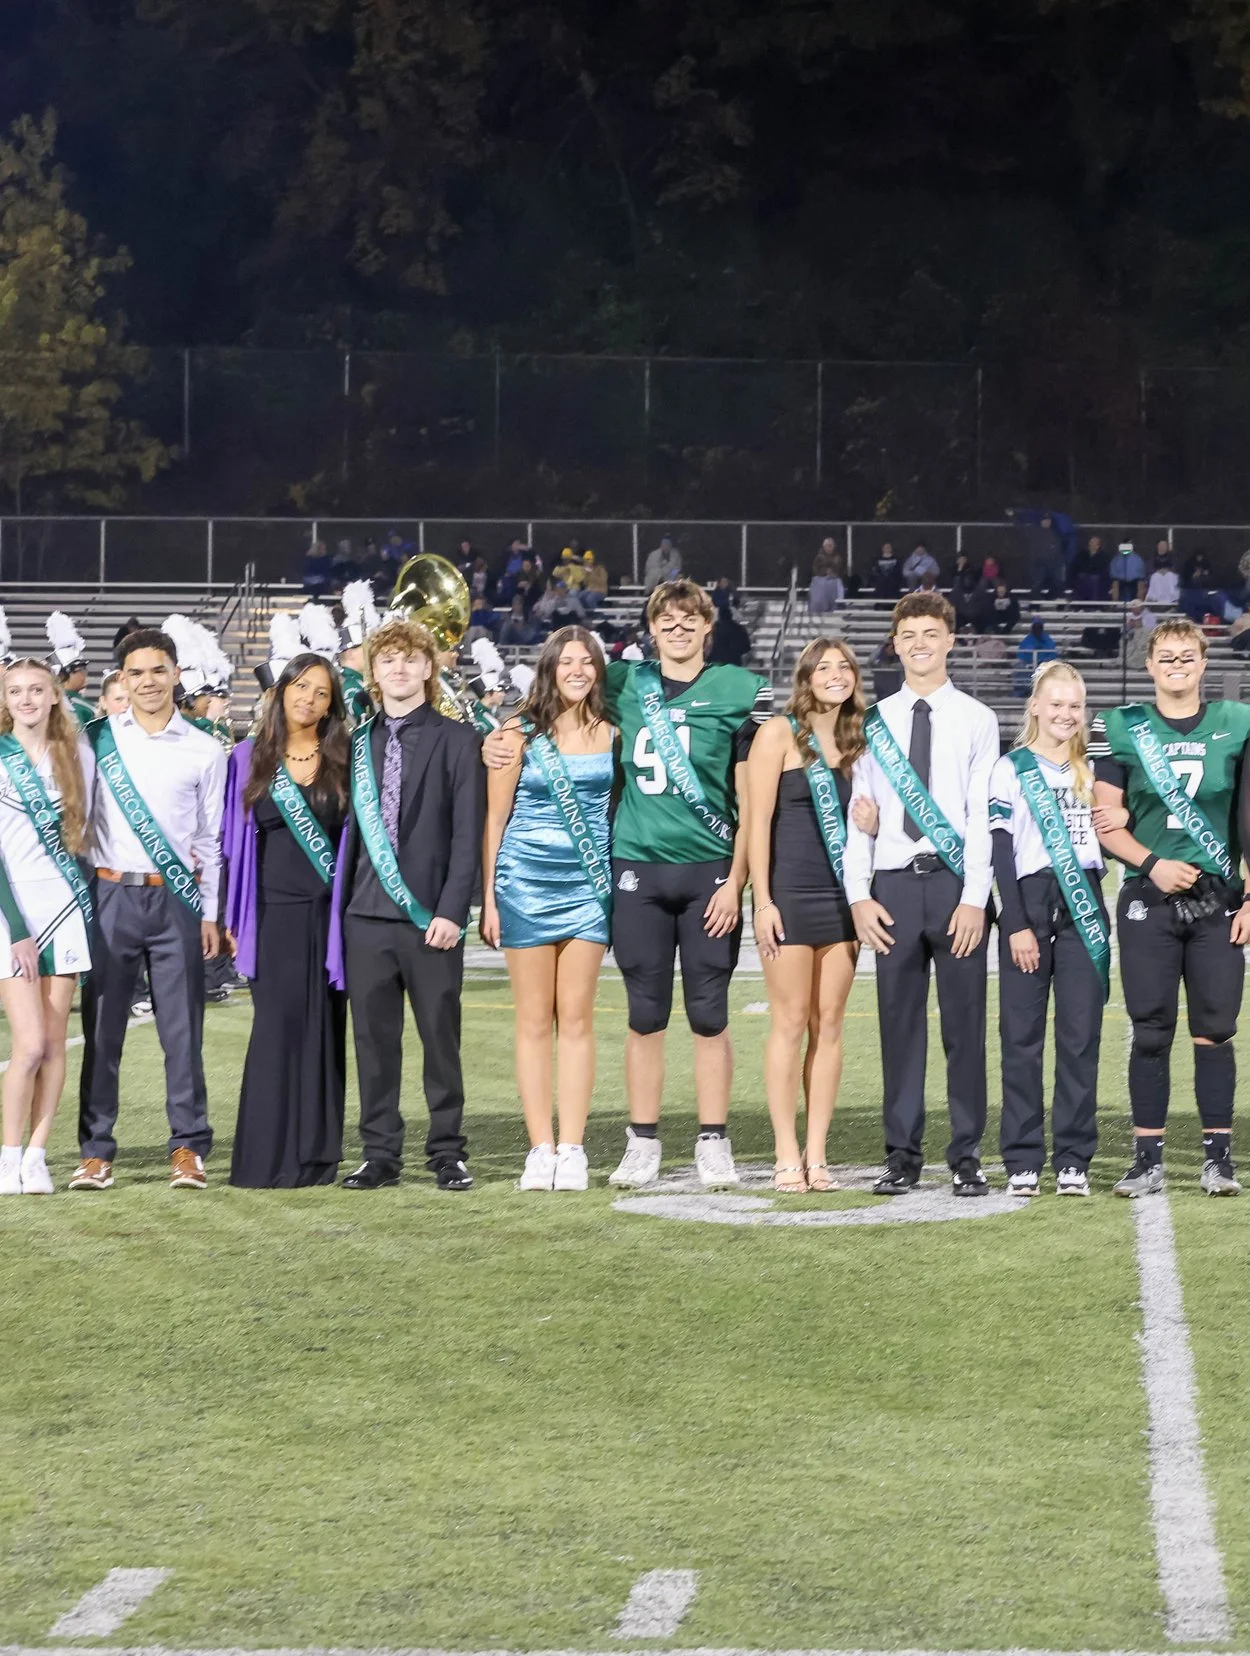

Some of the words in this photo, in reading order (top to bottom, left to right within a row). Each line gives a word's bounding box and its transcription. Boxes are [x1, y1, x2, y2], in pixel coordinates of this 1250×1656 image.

[643, 691, 699, 804] HOMECOMING
[865, 720, 938, 828] HOMECOMING
[1133, 721, 1204, 833] HOMECOMING
[1166, 759, 1205, 830] 7
[7, 753, 71, 867] HOMECOMING
[101, 751, 172, 866] HOMECOMING
[354, 734, 383, 848] HOMECOMING
[375, 850, 412, 908] COURT
[1022, 769, 1081, 887] HOMECOMING
[1071, 887, 1105, 945] COURT
[578, 838, 612, 895] COURT
